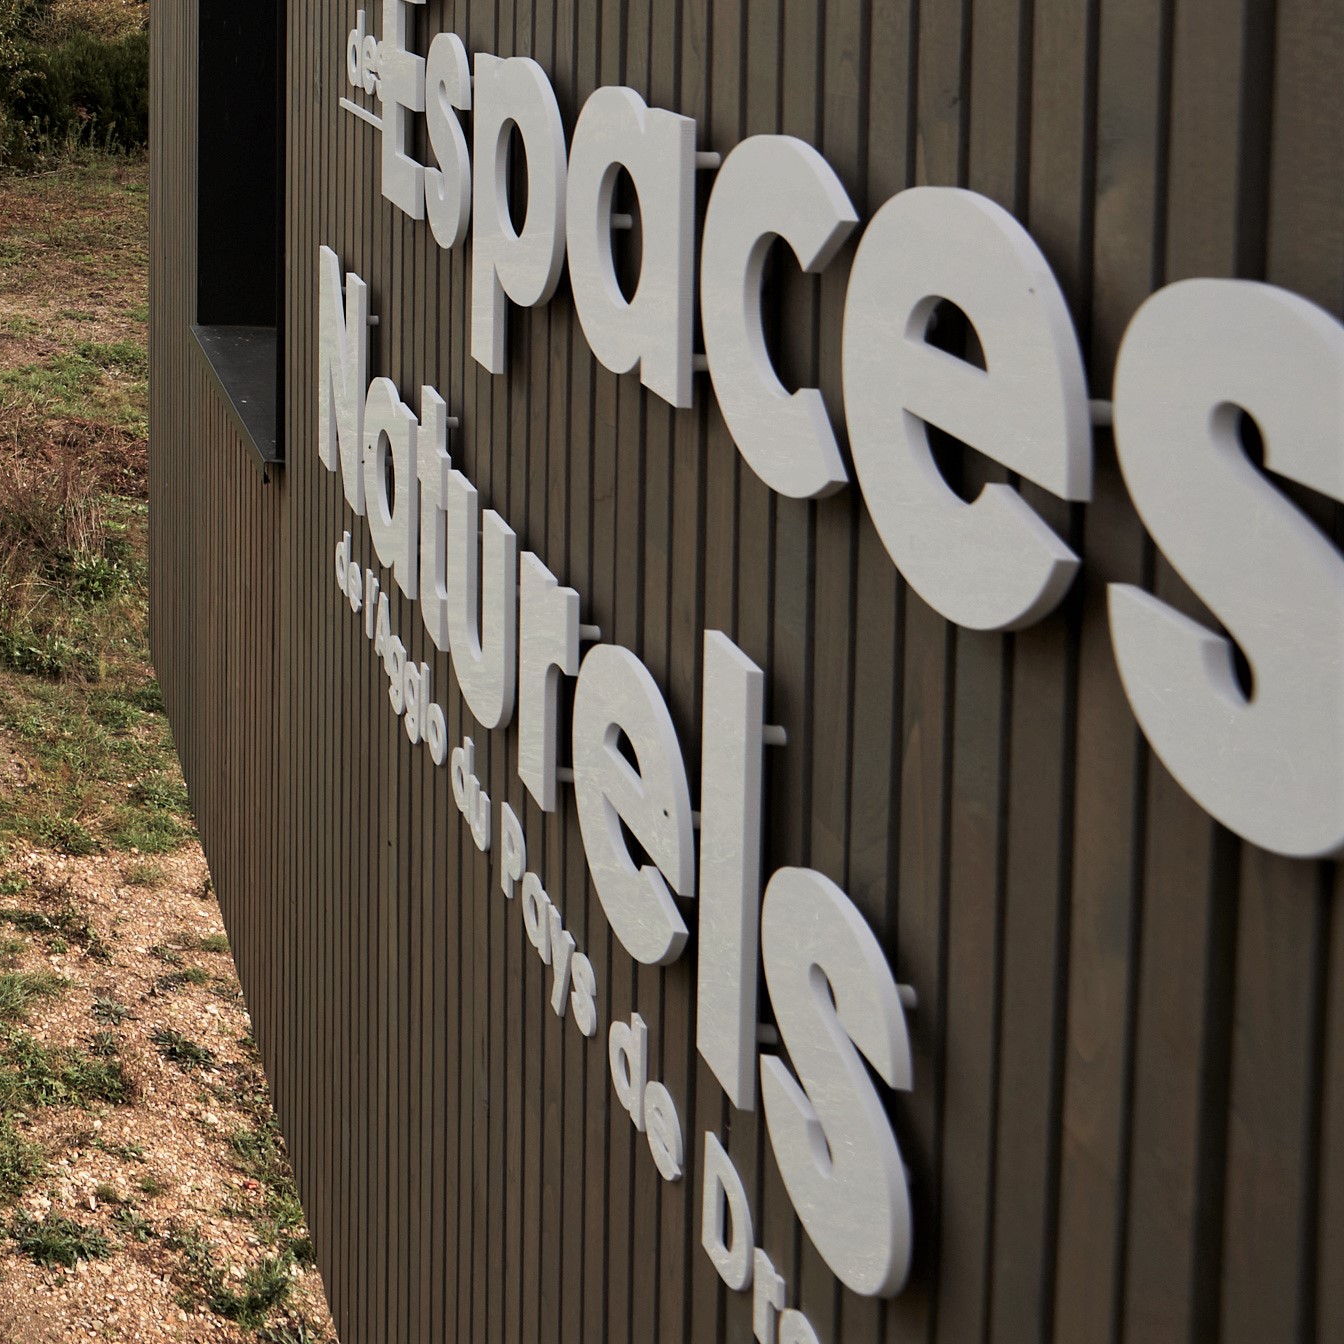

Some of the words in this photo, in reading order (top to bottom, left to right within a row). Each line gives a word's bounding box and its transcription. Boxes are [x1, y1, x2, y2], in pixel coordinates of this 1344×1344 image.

[319, 245, 912, 1298] Naturels
[335, 530, 362, 614] de
[365, 567, 447, 766] l'Agglo
[451, 736, 491, 852] du
[500, 801, 597, 1037] Pays
[608, 1012, 684, 1182] de
